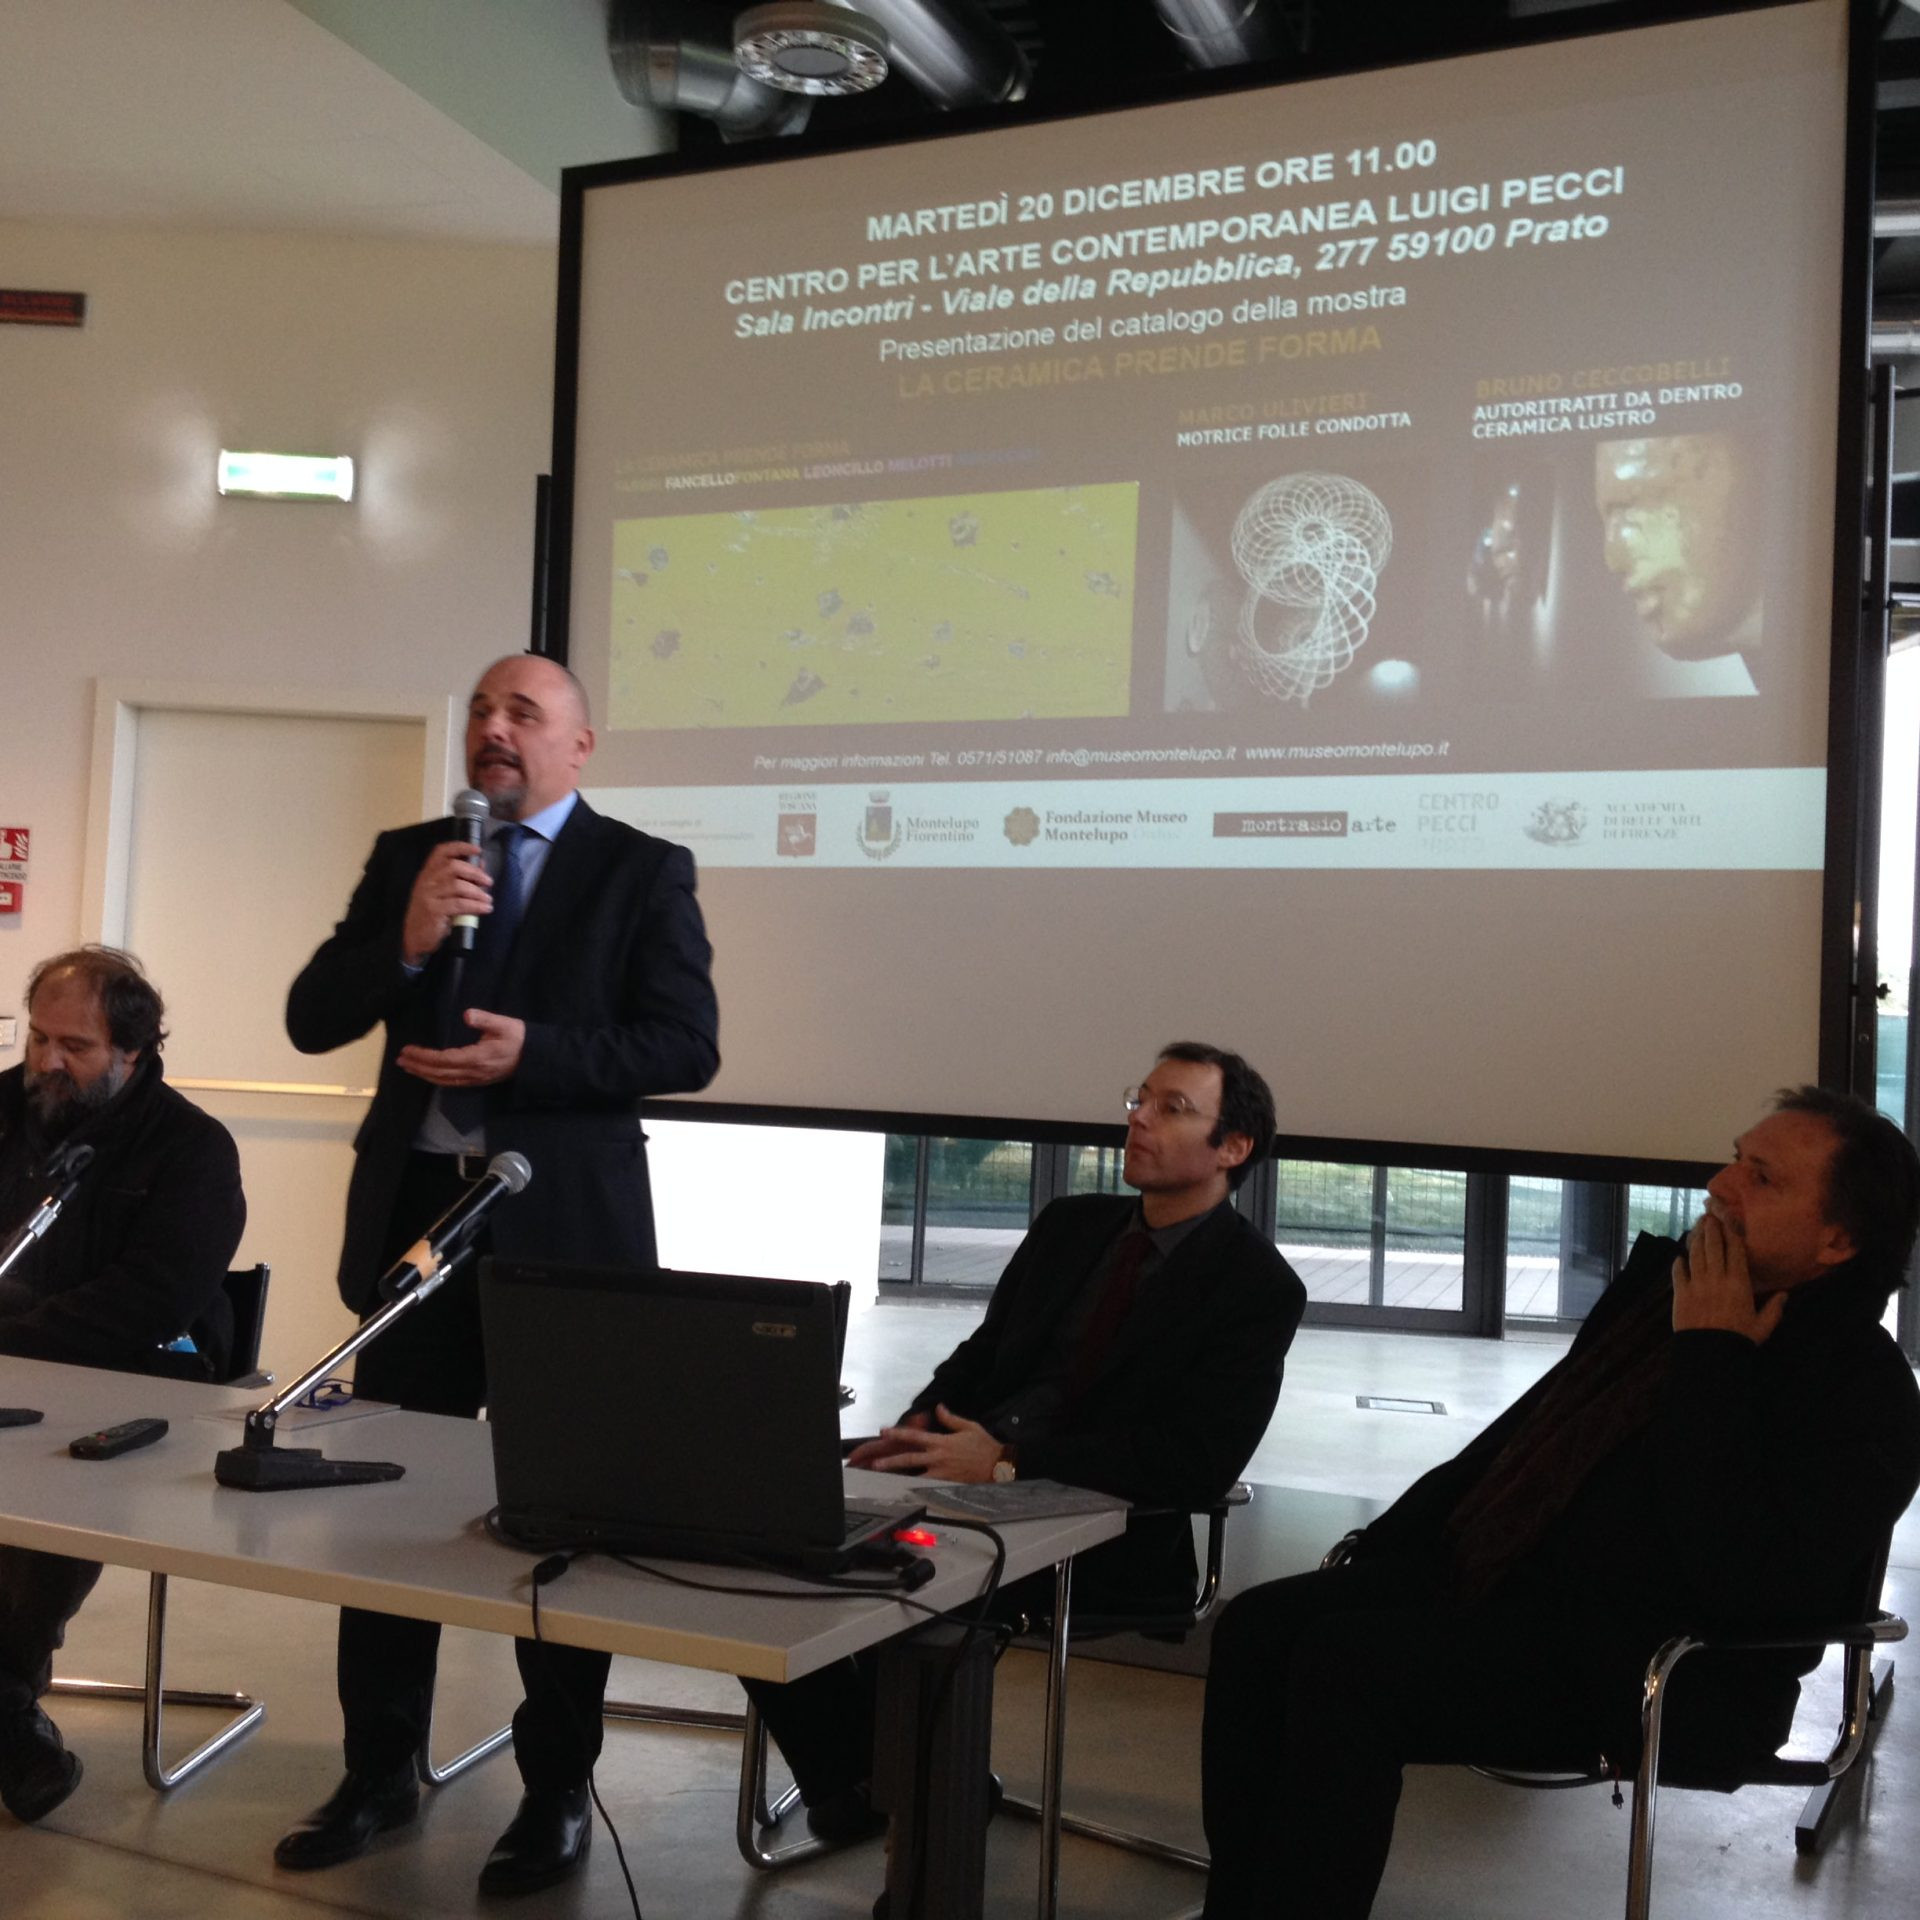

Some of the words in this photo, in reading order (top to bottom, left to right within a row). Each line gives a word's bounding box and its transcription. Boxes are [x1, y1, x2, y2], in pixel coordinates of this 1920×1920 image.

[867, 192, 1008, 241] MARTEDÌ
[1017, 192, 1054, 222] 20
[1063, 166, 1246, 216] DICEMBRE
[1255, 153, 1334, 188] ORE
[1345, 139, 1437, 176] 11.00
[725, 266, 849, 306] CENTRO
[857, 259, 919, 289] PER
[1051, 200, 1377, 265] CONTEMPORANEA
[1387, 184, 1490, 222] LUIGI
[1501, 166, 1625, 208] PECCI
[735, 309, 793, 338] Sala
[803, 294, 914, 331] Incontri
[942, 287, 1014, 316] Viale
[1022, 274, 1096, 306] della
[1107, 252, 1301, 298] Repubblica,
[1315, 238, 1378, 271] 277
[1387, 222, 1496, 262] 59100
[1505, 213, 1608, 247] Prato
[879, 326, 1055, 363] Presentazione
[1063, 317, 1102, 343] del
[1111, 303, 1223, 337] catalogo
[1232, 296, 1298, 323] della
[1307, 285, 1406, 316] mostra
[899, 373, 935, 398] LA
[944, 359, 1102, 394] CERAMICA
[1114, 340, 1246, 376] PRENDE
[1257, 325, 1382, 363] FORMA
[1476, 374, 1562, 398] BRUNO
[1572, 357, 1730, 388] CECCOBELLI
[1178, 403, 1253, 425] MARCO
[1263, 391, 1368, 418] ULIVIERI
[1473, 393, 1617, 420] AUTORITRATTI
[1625, 390, 1652, 407] DA
[1659, 382, 1743, 404] DENTRO
[1177, 426, 1252, 447] MOTRICE
[1257, 421, 1310, 440] FOLLE
[1315, 412, 1411, 435] CONDOTTA
[1472, 417, 1572, 439] CERAMICA
[1579, 409, 1656, 429] LUSTRO
[803, 460, 884, 480] LEONCILLO
[754, 756, 777, 769] Per
[841, 753, 926, 768] informazioni
[957, 750, 1043, 765] 0571/51087
[1046, 746, 1238, 768] info@museomontelupo.it
[1245, 740, 1450, 762] www.museomontelupo.it
[1418, 793, 1500, 811] CENTRO
[906, 815, 980, 831] Montelupo
[1045, 810, 1133, 825] Fondazione
[1137, 810, 1188, 825] Museo
[1241, 817, 1342, 833] montrasio
[1351, 818, 1396, 833] arte
[1417, 814, 1477, 833] PECCI
[905, 830, 975, 843] Fiorentino
[1045, 827, 1128, 845] Montelupo
